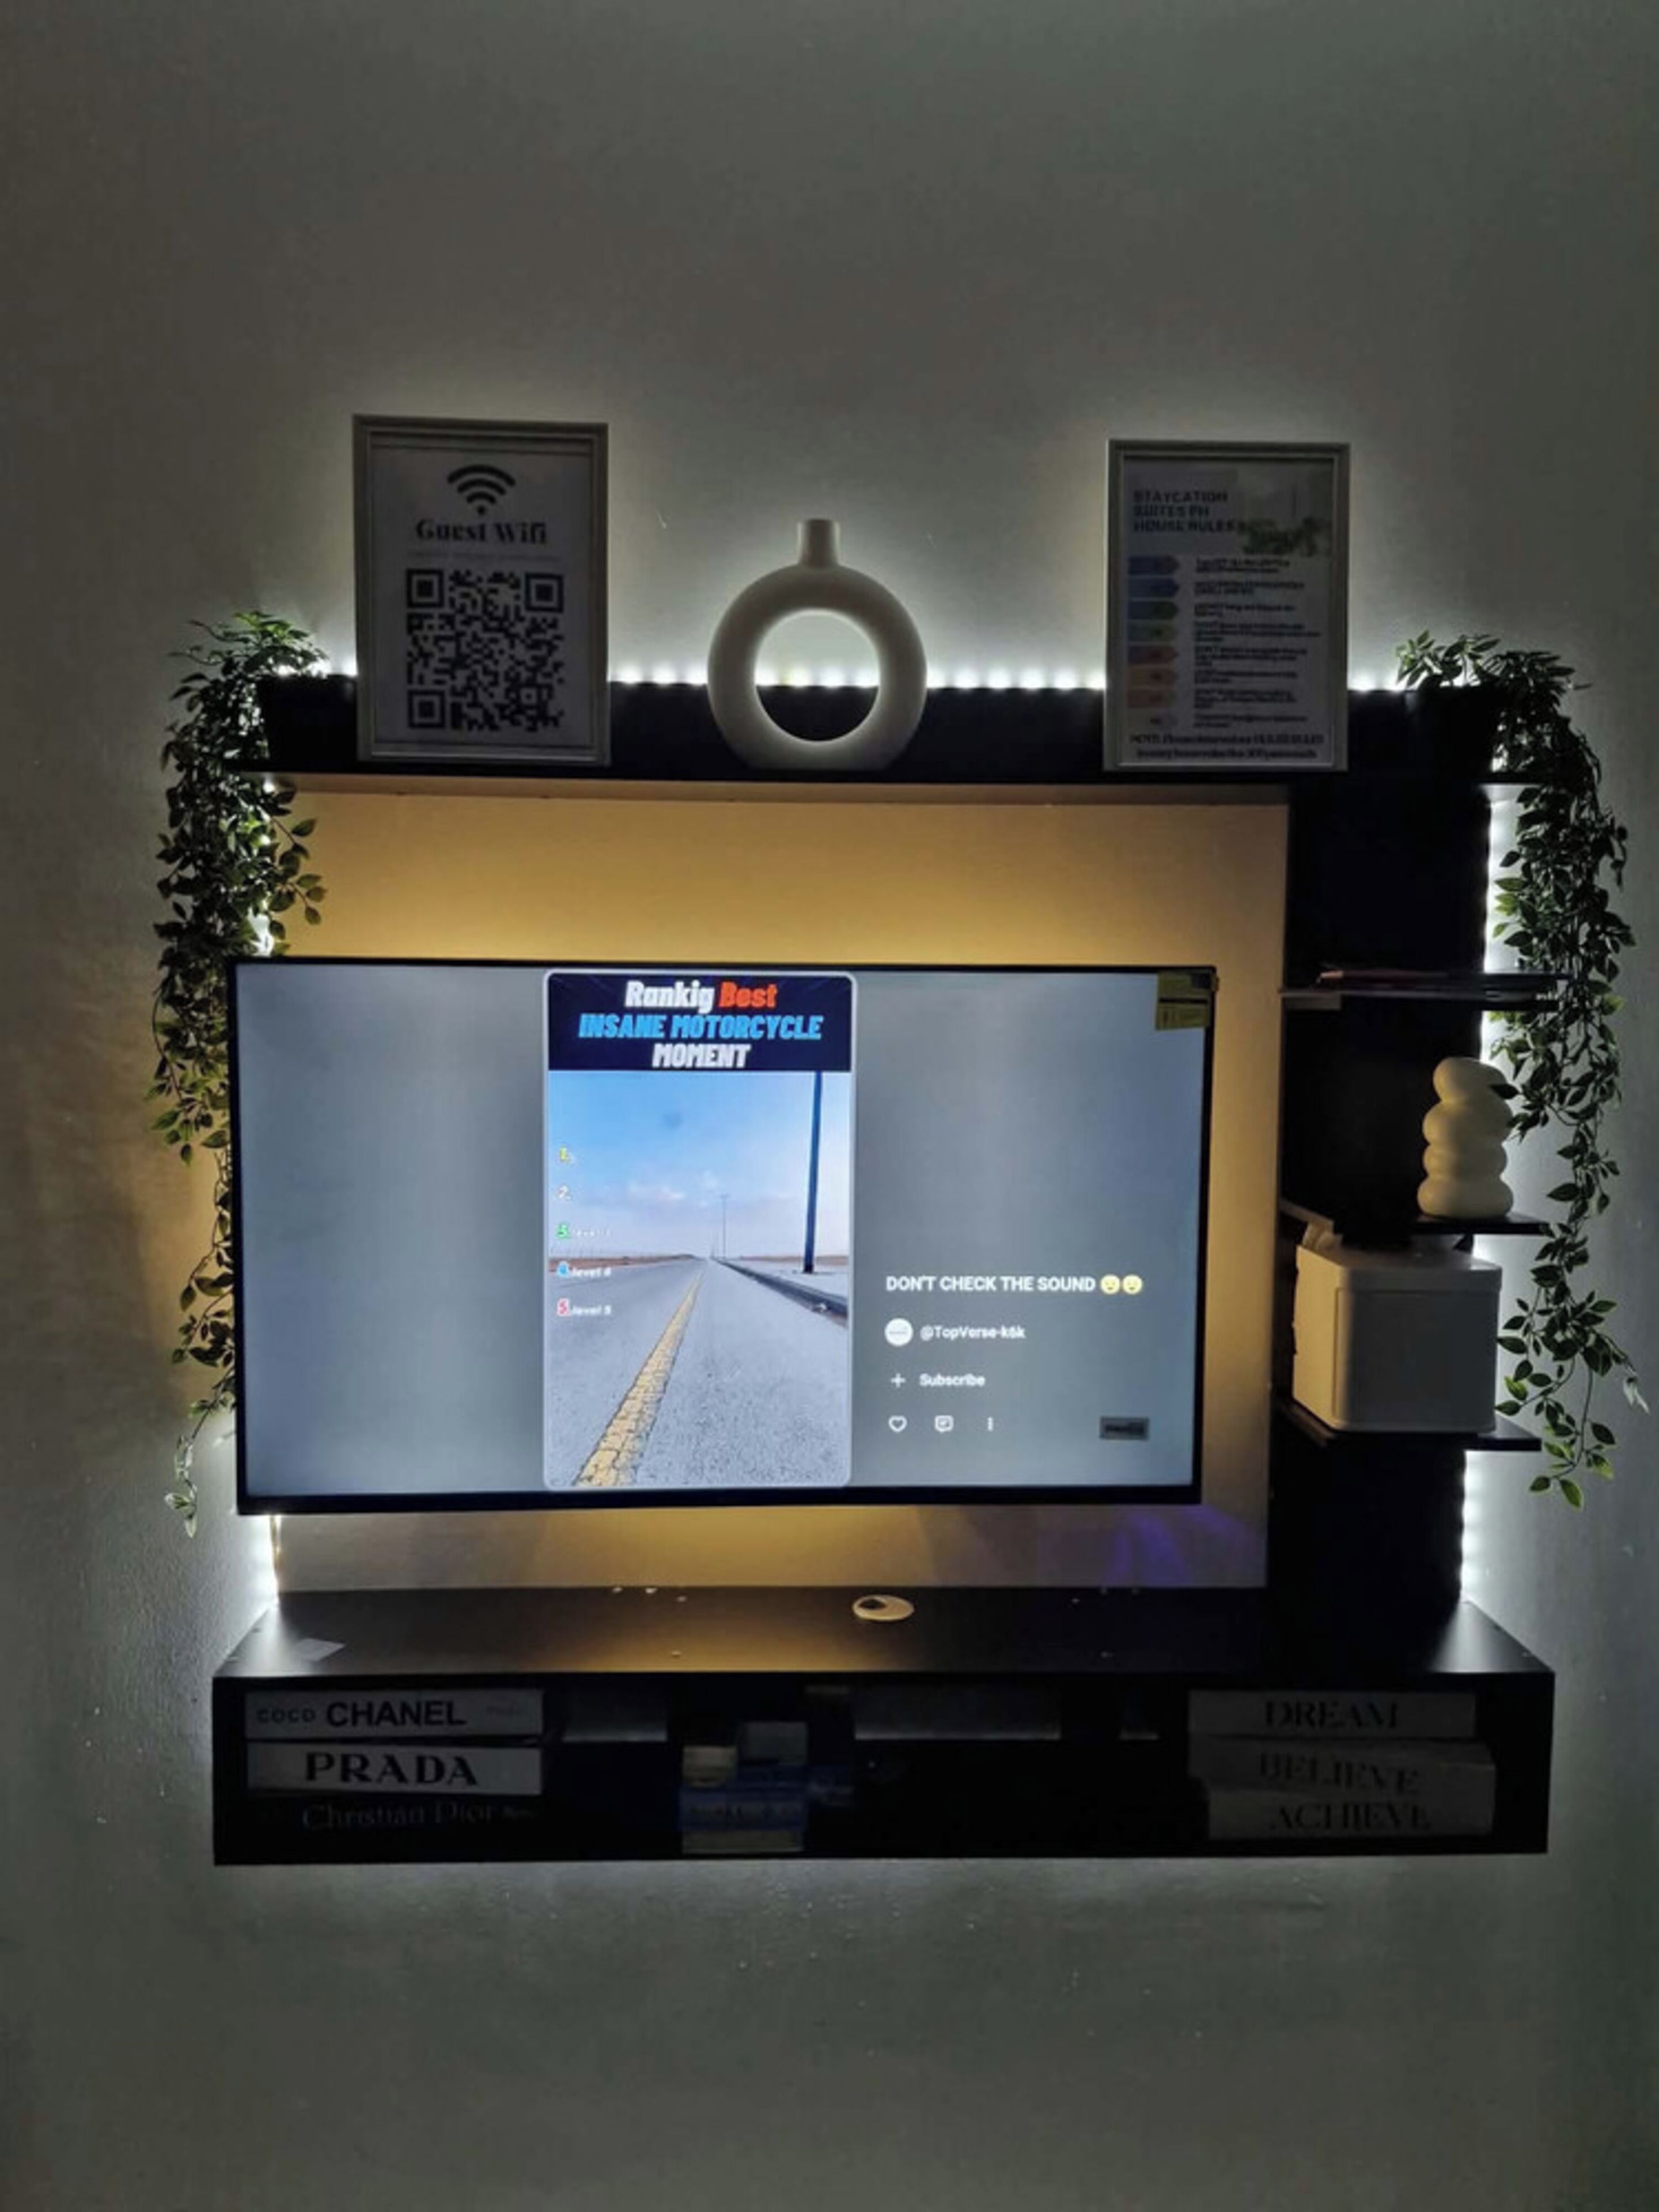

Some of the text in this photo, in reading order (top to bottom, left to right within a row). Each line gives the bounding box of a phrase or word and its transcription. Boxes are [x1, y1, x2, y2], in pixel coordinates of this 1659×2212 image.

[416, 519, 547, 544] Guest Wifi
[625, 980, 778, 1014] Rankig Best
[578, 1013, 825, 1040] INSANE MOTORCYCLE
[652, 1043, 751, 1069] MOMENT
[886, 1275, 1096, 1292] DON'T CHECK THE SOUND
[919, 1373, 986, 1387] Subscribe
[326, 1700, 468, 1728] CHANEL
[1264, 1700, 1399, 1729] DREAM
[305, 1751, 478, 1786] PRADA
[1259, 1752, 1421, 1796] BELIEVE
[302, 1802, 425, 1831] Christian
[434, 1800, 494, 1825] Dior
[1270, 1802, 1431, 1831] ACHIEVE
